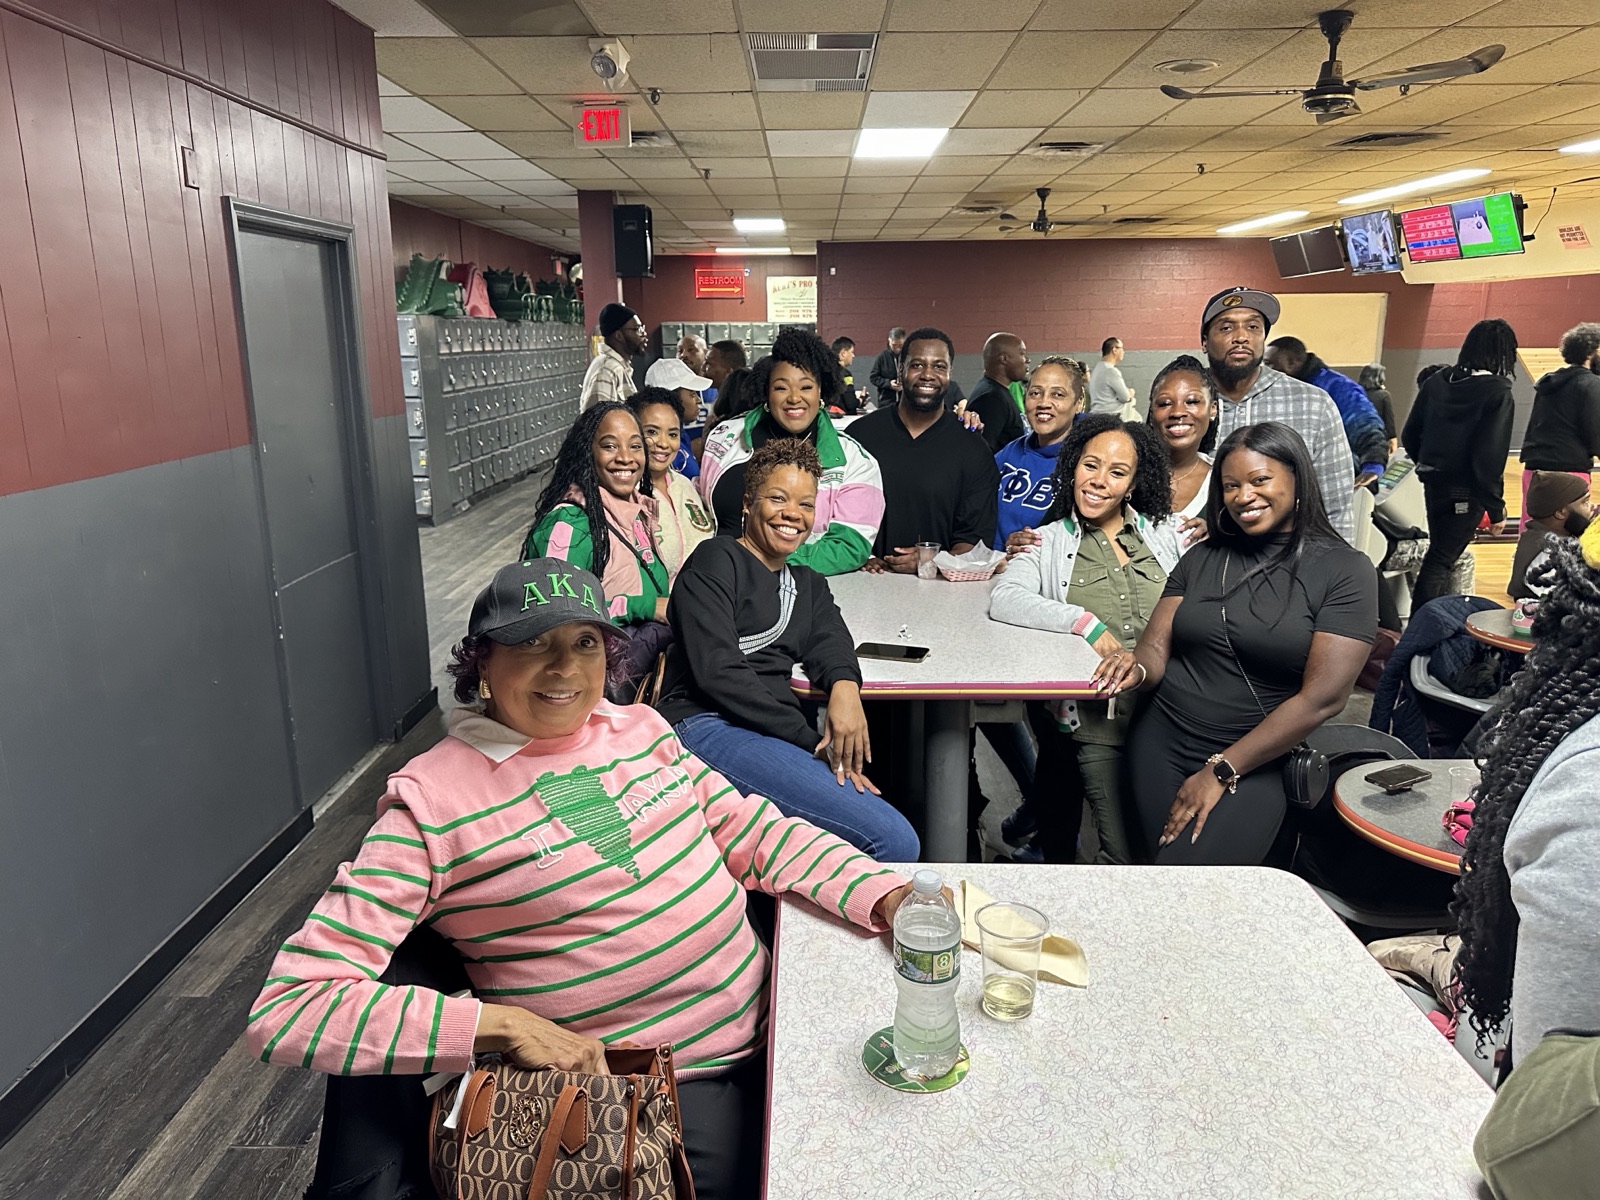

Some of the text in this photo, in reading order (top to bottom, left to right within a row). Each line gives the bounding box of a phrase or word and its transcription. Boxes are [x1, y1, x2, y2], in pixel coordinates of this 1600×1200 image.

[583, 109, 620, 141] EXIT
[698, 276, 742, 285] RESTROOM
[798, 280, 812, 288] PRO
[520, 573, 601, 615] AKA
[622, 765, 694, 823] AKA
